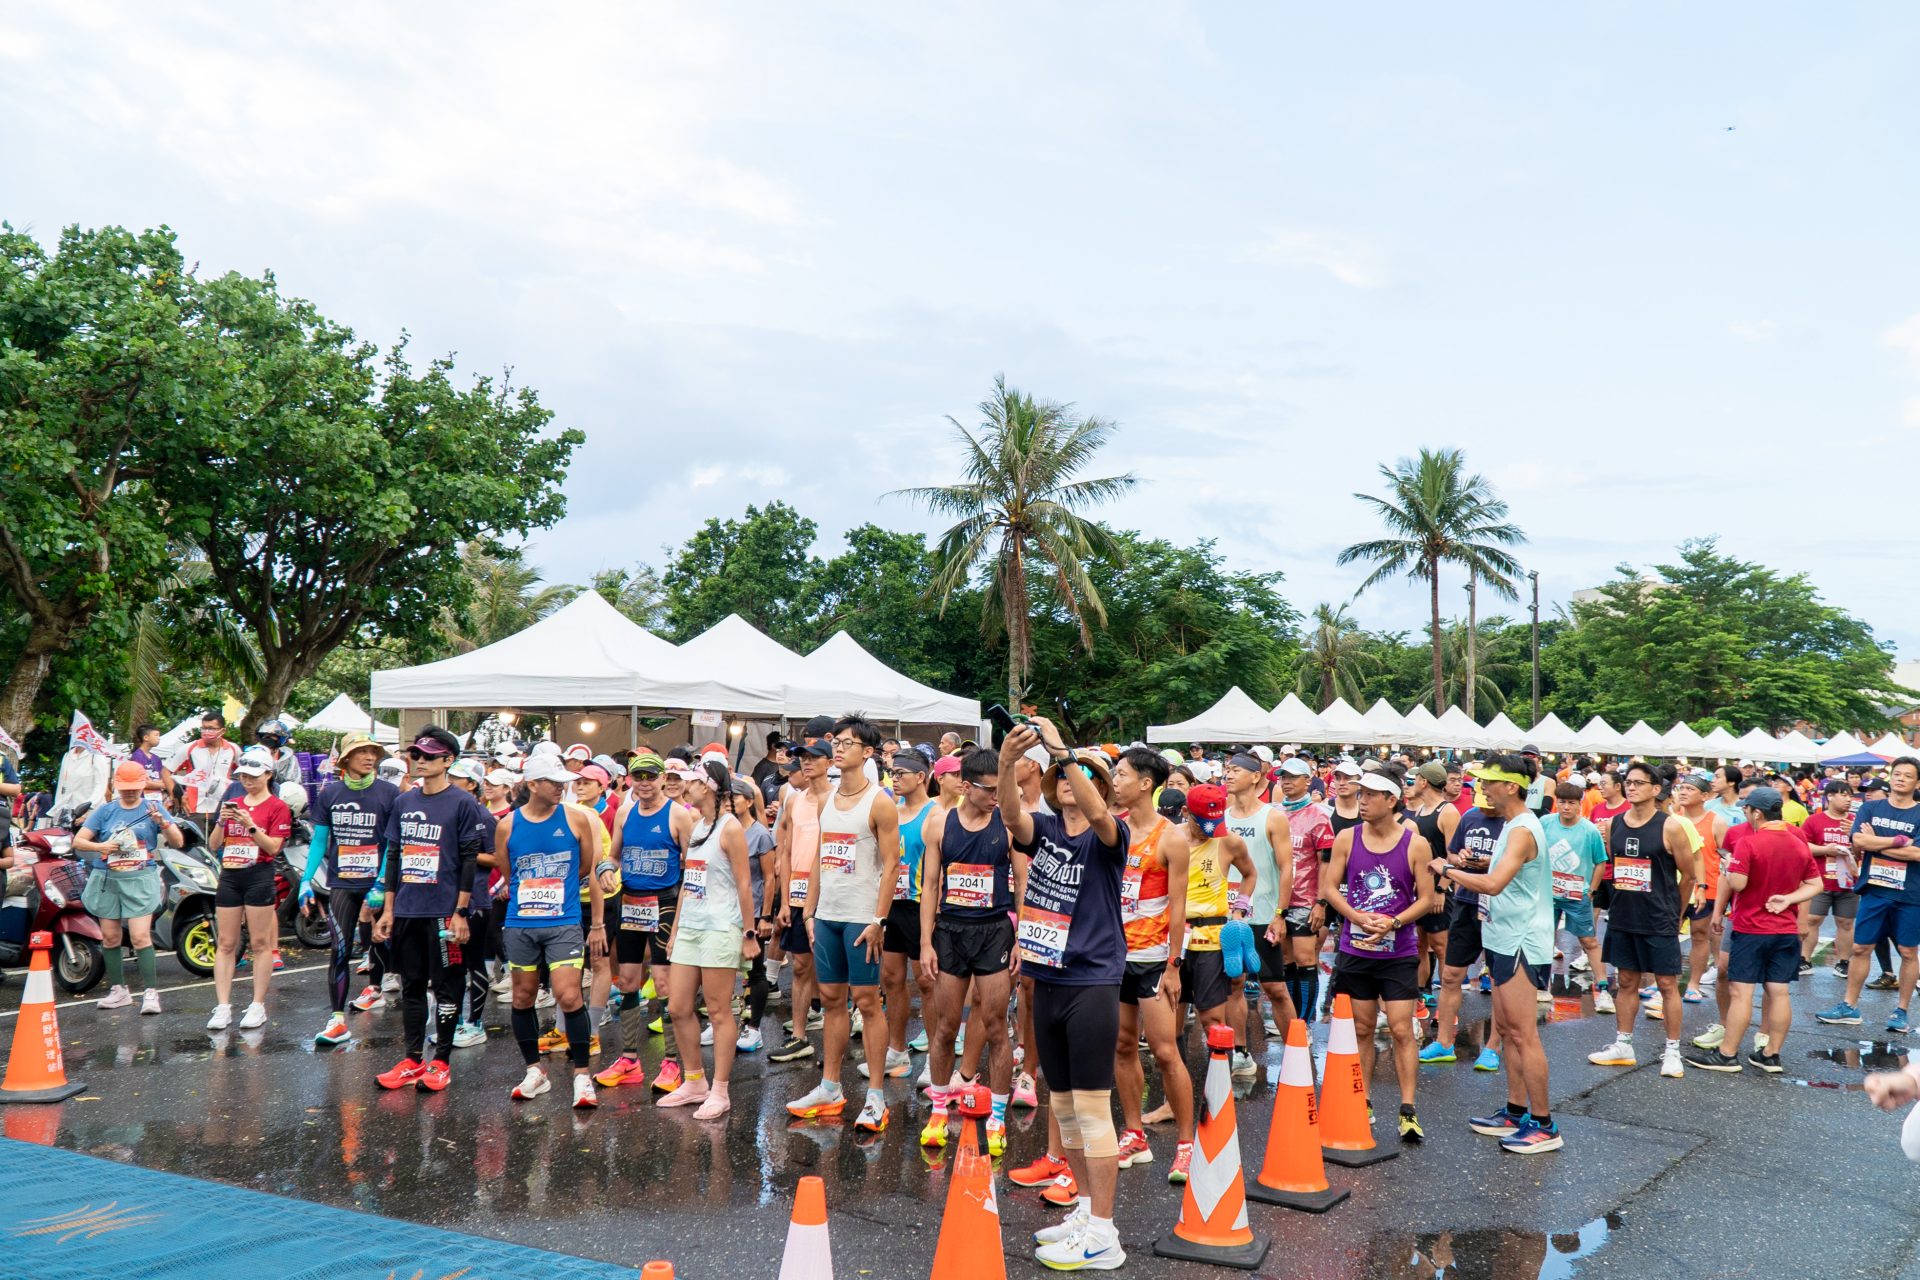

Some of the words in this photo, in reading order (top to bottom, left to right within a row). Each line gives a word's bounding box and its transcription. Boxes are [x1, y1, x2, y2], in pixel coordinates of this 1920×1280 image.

[231, 847, 250, 855] 2061
[828, 846, 849, 855] 2187
[349, 856, 371, 865] 3079
[409, 857, 431, 866] 3009
[686, 871, 702, 881] 3135
[1198, 859, 1213, 888] 旗山
[1623, 868, 1644, 877] 2135
[1880, 867, 1899, 877] 3041
[797, 881, 807, 891] 30
[959, 877, 984, 888] 2041
[1553, 880, 1566, 888] 062
[531, 890, 557, 900] 3040
[631, 907, 652, 916] 3042
[1026, 925, 1058, 943] 3072
